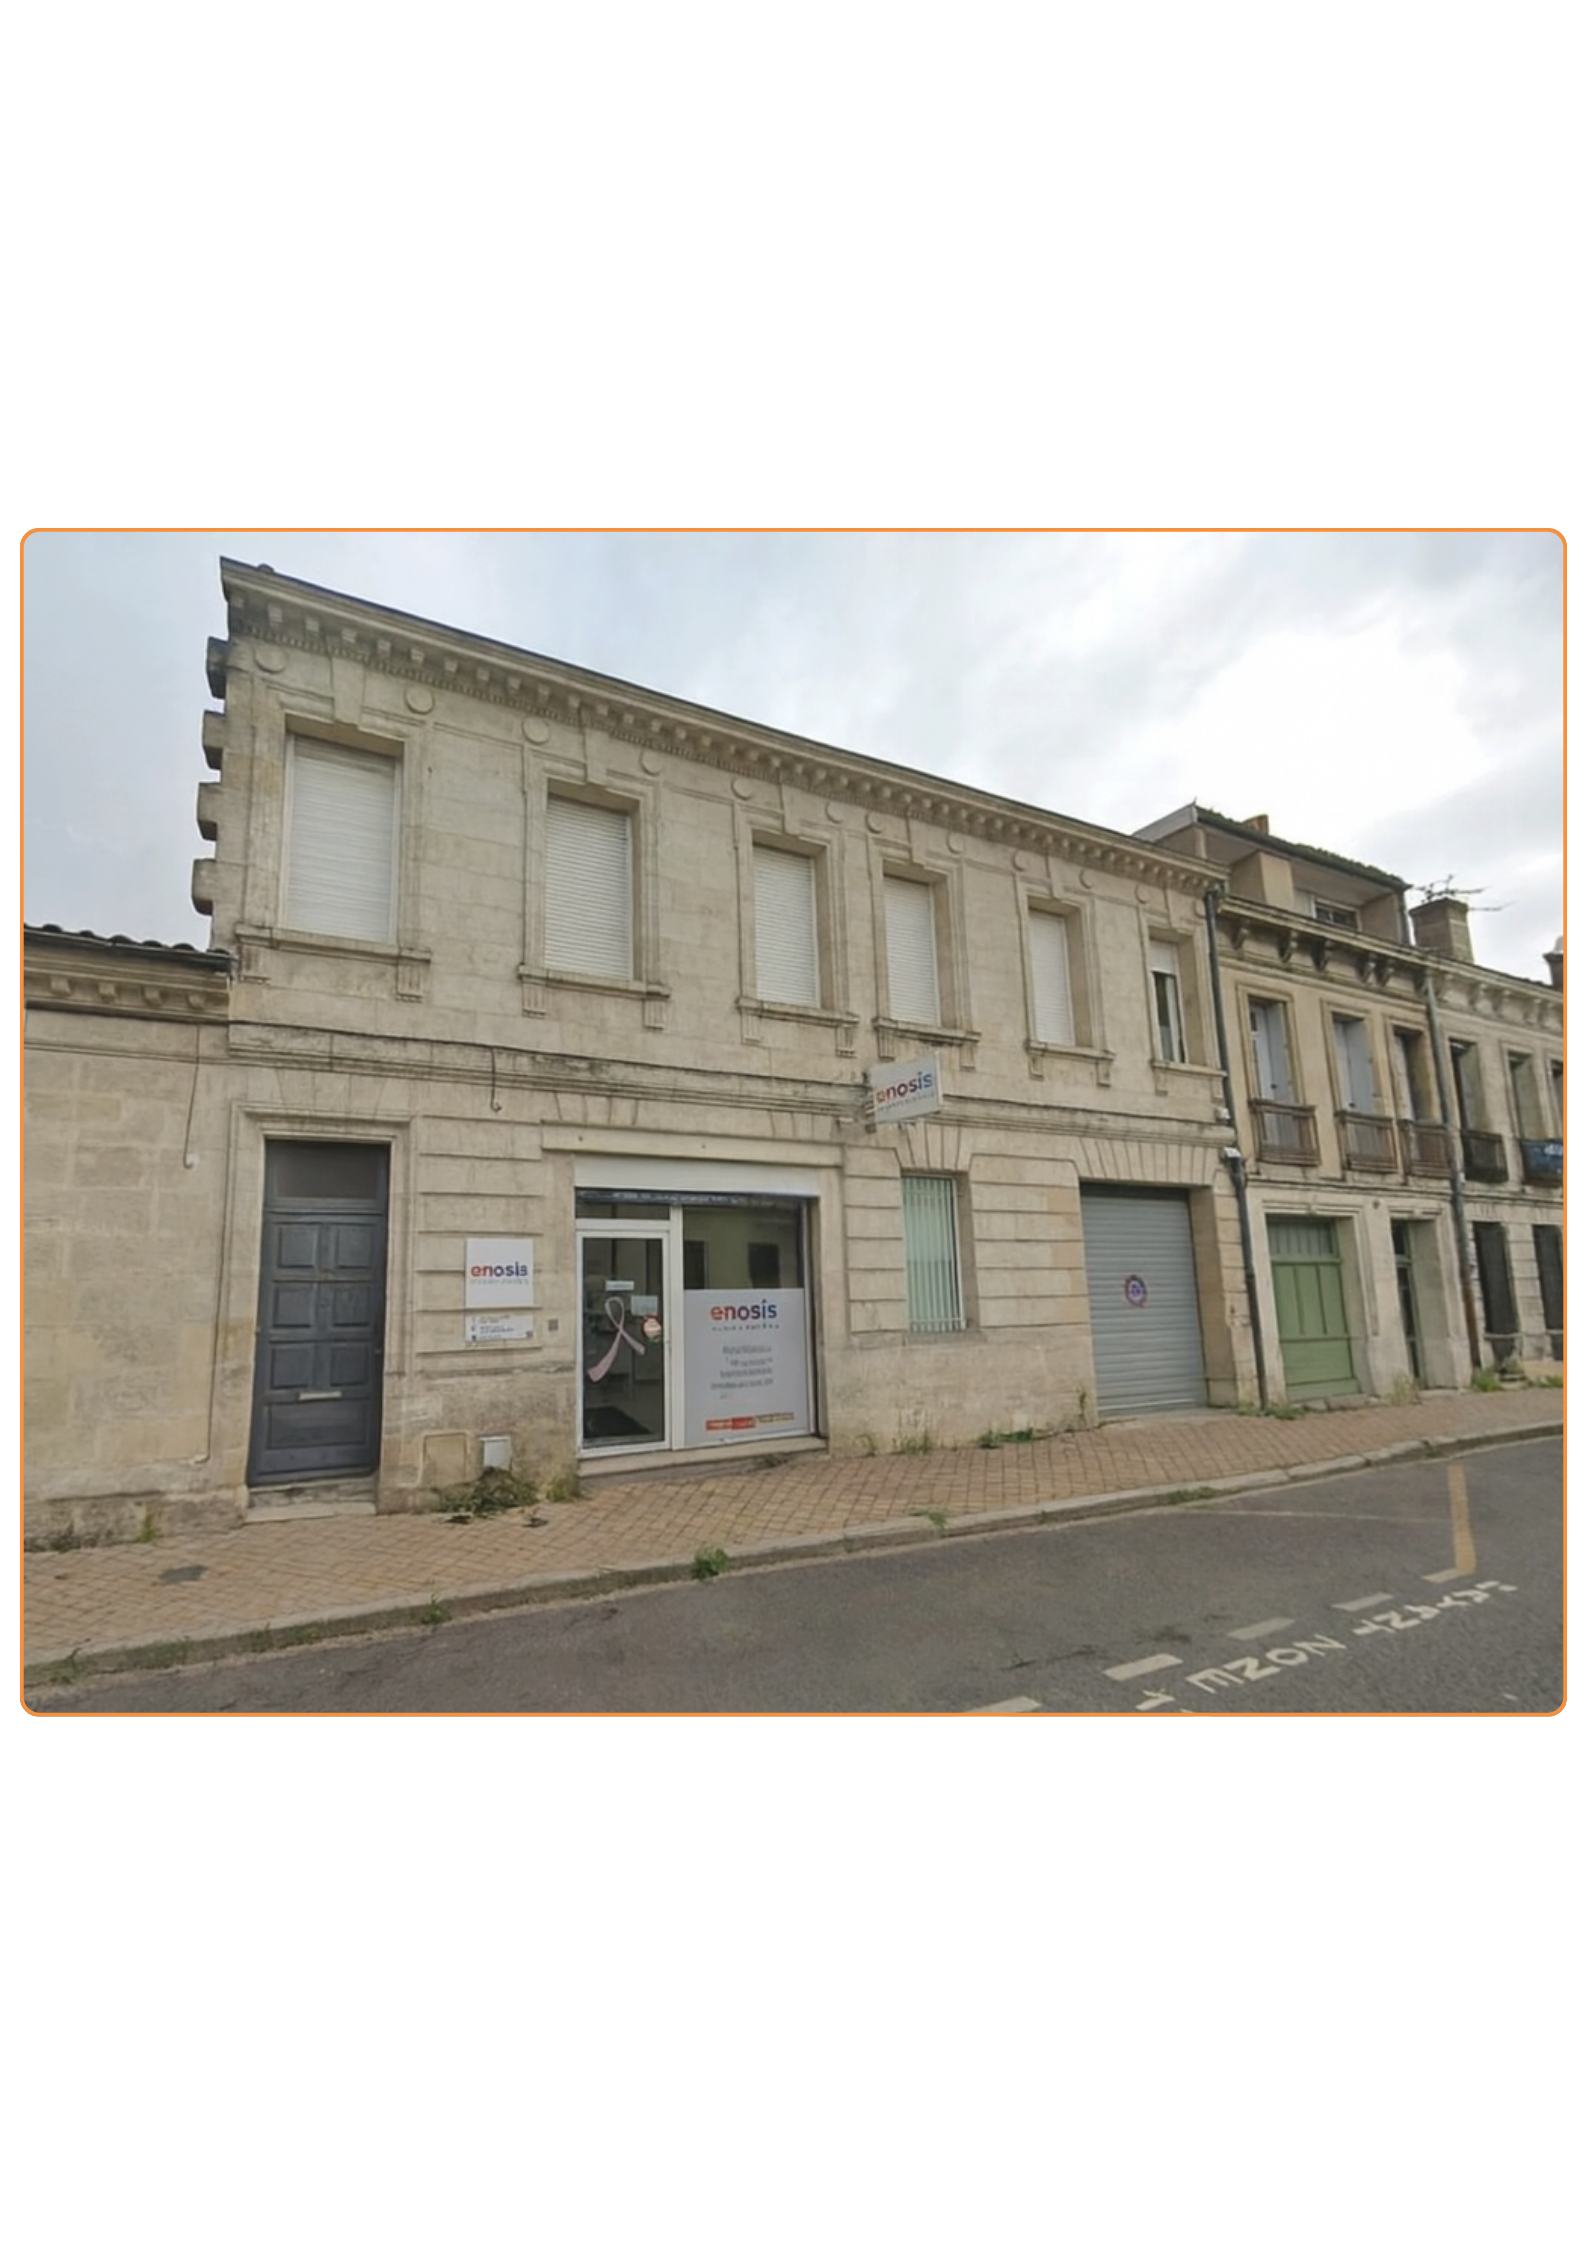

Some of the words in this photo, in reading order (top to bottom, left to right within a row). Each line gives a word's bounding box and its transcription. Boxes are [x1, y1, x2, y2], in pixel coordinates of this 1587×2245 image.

[875, 1071, 933, 1103] enosis
[470, 1261, 529, 1277] enosis
[709, 1298, 778, 1321] enosis
